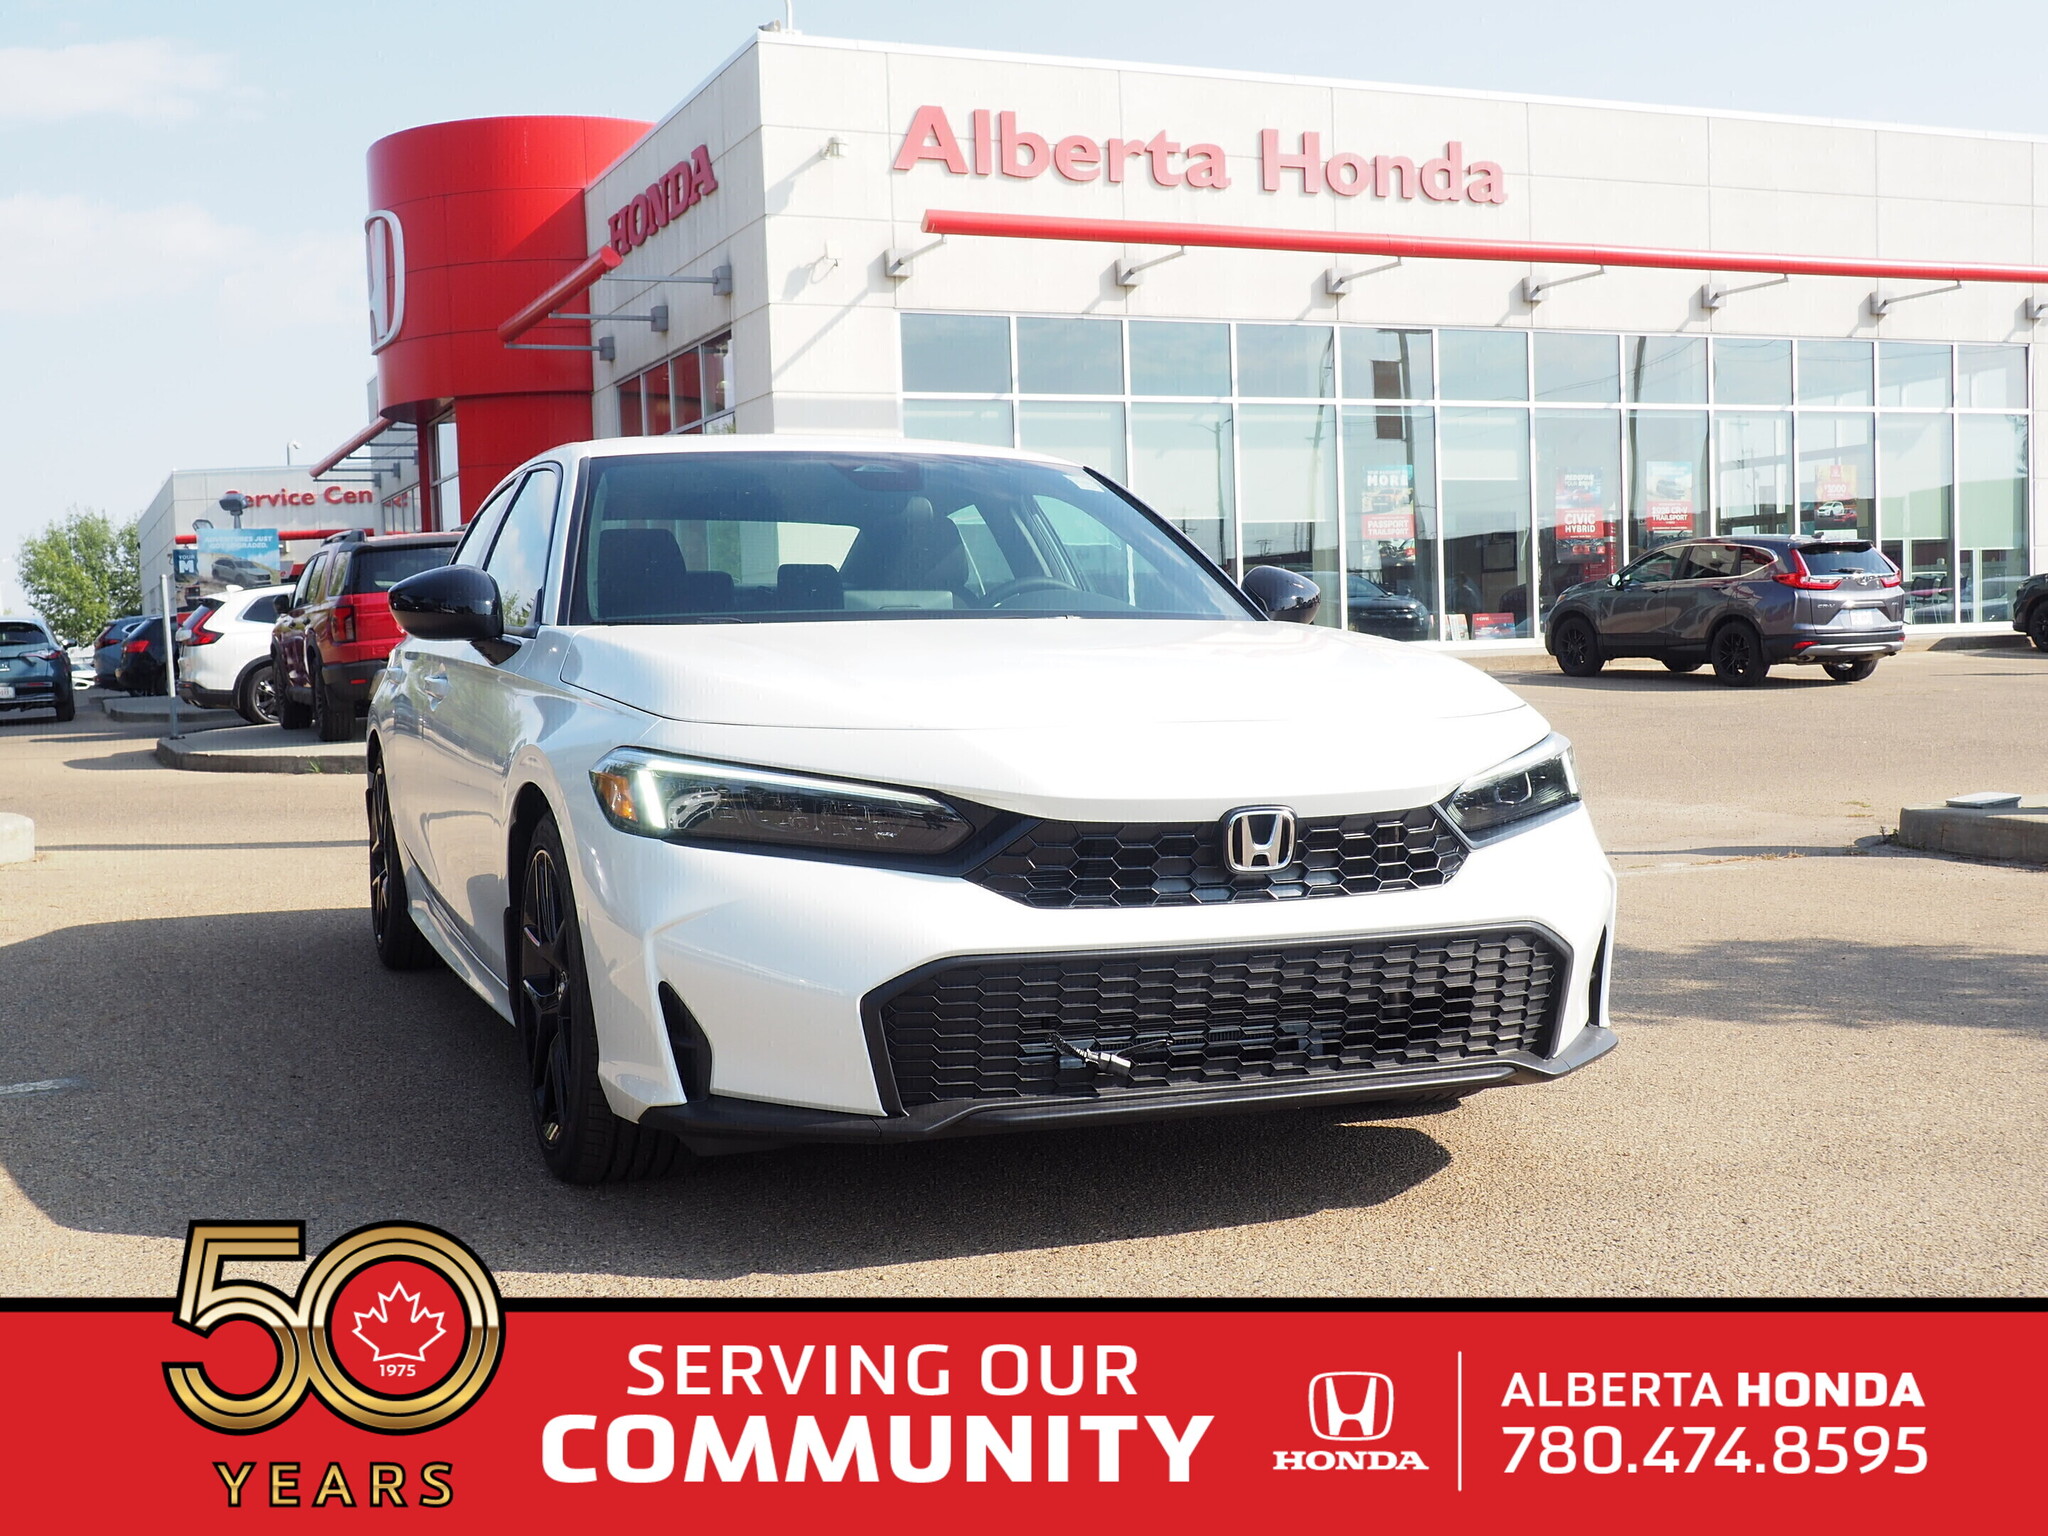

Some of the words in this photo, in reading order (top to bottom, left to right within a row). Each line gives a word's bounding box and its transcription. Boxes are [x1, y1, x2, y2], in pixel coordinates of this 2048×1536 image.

[893, 104, 1232, 189] Alberta
[1260, 128, 1509, 204] Honda
[608, 144, 718, 256] HONDA
[225, 488, 316, 508] ervice
[1367, 519, 1410, 529] PASSPORT
[1564, 513, 1596, 525] CIVIC
[1564, 525, 1596, 533] HYBRID
